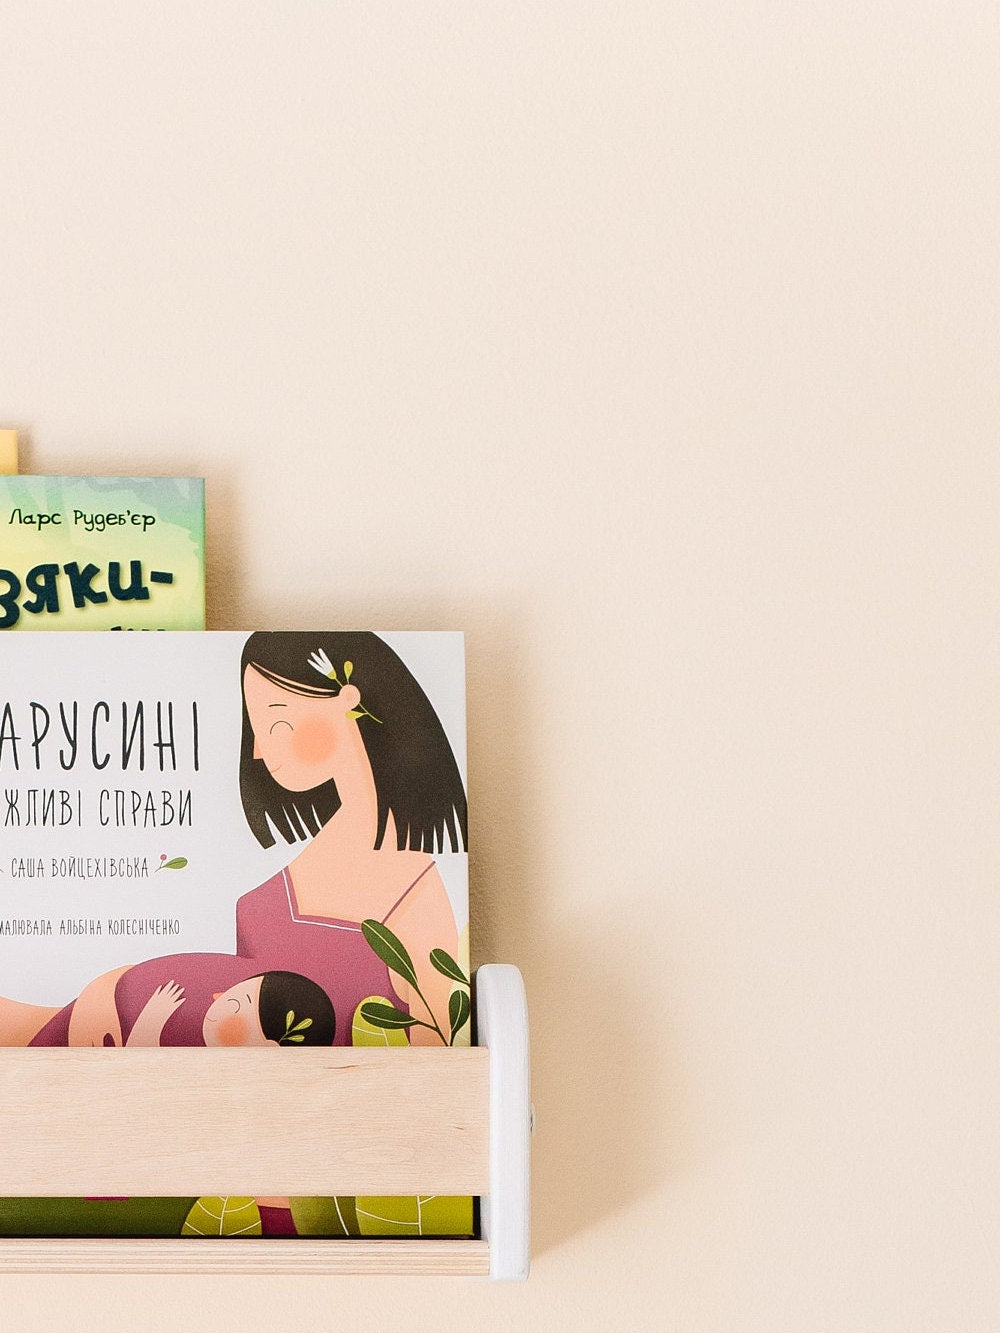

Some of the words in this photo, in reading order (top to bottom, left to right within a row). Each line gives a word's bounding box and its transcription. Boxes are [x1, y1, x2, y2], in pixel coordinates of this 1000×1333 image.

[8, 508, 62, 531] Ларс
[99, 789, 193, 827] СПРАВИ
[11, 857, 45, 878] САША
[51, 855, 149, 880] ВОЙЦЕХІВСЬКА
[59, 919, 102, 936] АЛЬБІНА
[108, 919, 181, 936] КОЛЕСНІЧЕНКО
